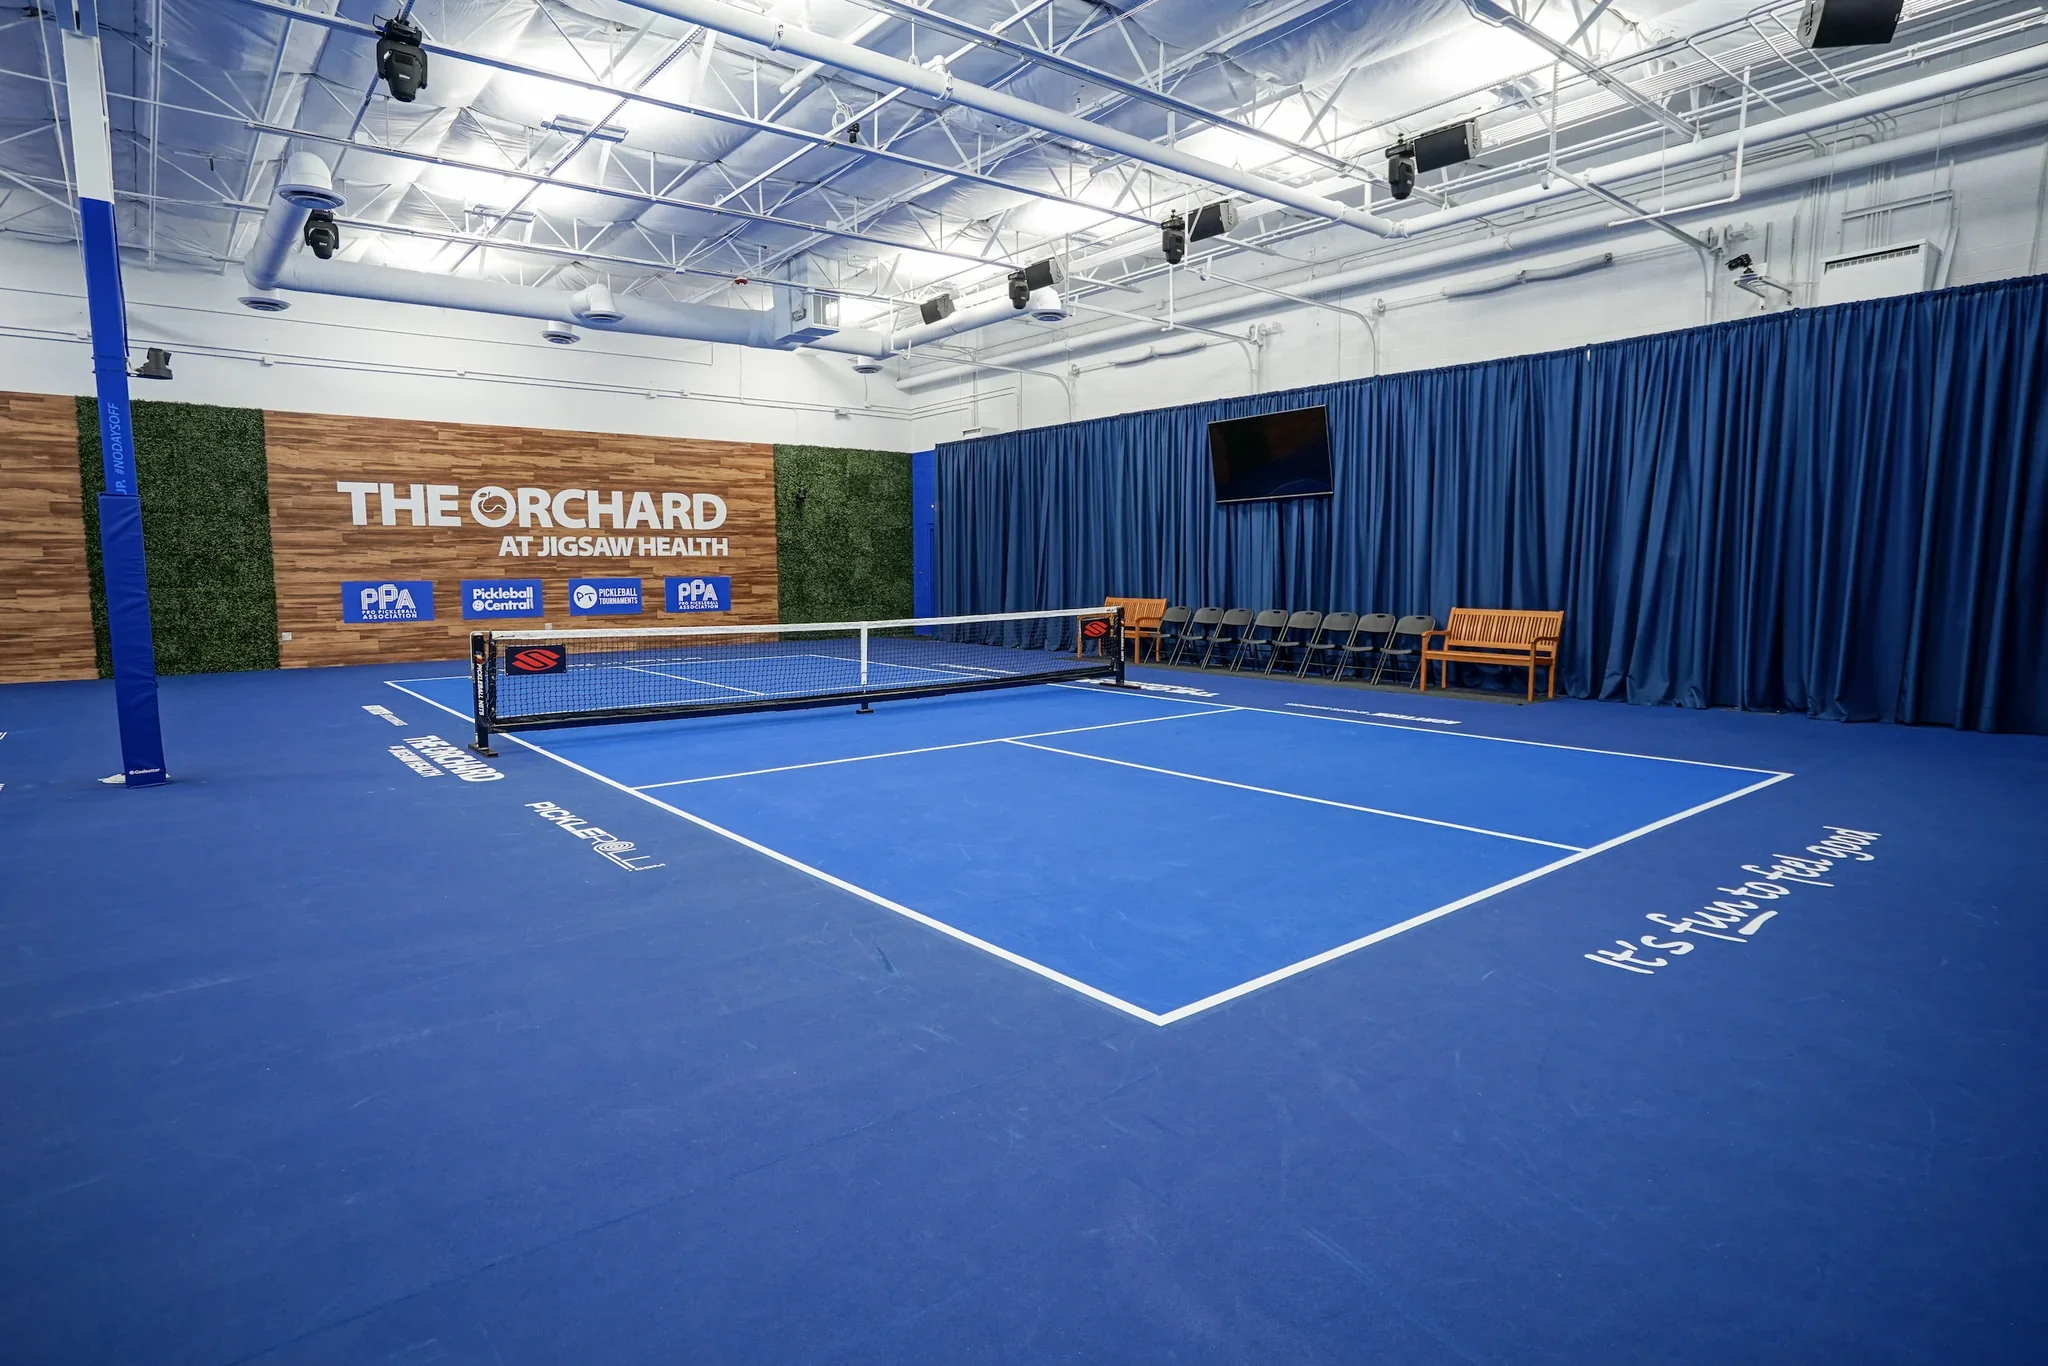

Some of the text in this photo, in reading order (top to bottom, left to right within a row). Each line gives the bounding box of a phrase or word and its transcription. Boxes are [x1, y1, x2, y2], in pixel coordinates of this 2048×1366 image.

[107, 402, 125, 475] #NODAYSOFF
[337, 481, 728, 530] THE ORCHARD
[498, 536, 729, 557] AT JIGSAW HEALTH
[361, 583, 417, 610] PPA
[472, 586, 534, 600] Pickleball
[598, 587, 638, 597] PICKLEBALL
[598, 597, 638, 605] TOURNAMENTS
[678, 579, 718, 602] PPA
[483, 598, 534, 611] Central
[420, 746, 505, 782] ORCHARD
[1584, 826, 1882, 974] It's fun to feel good
